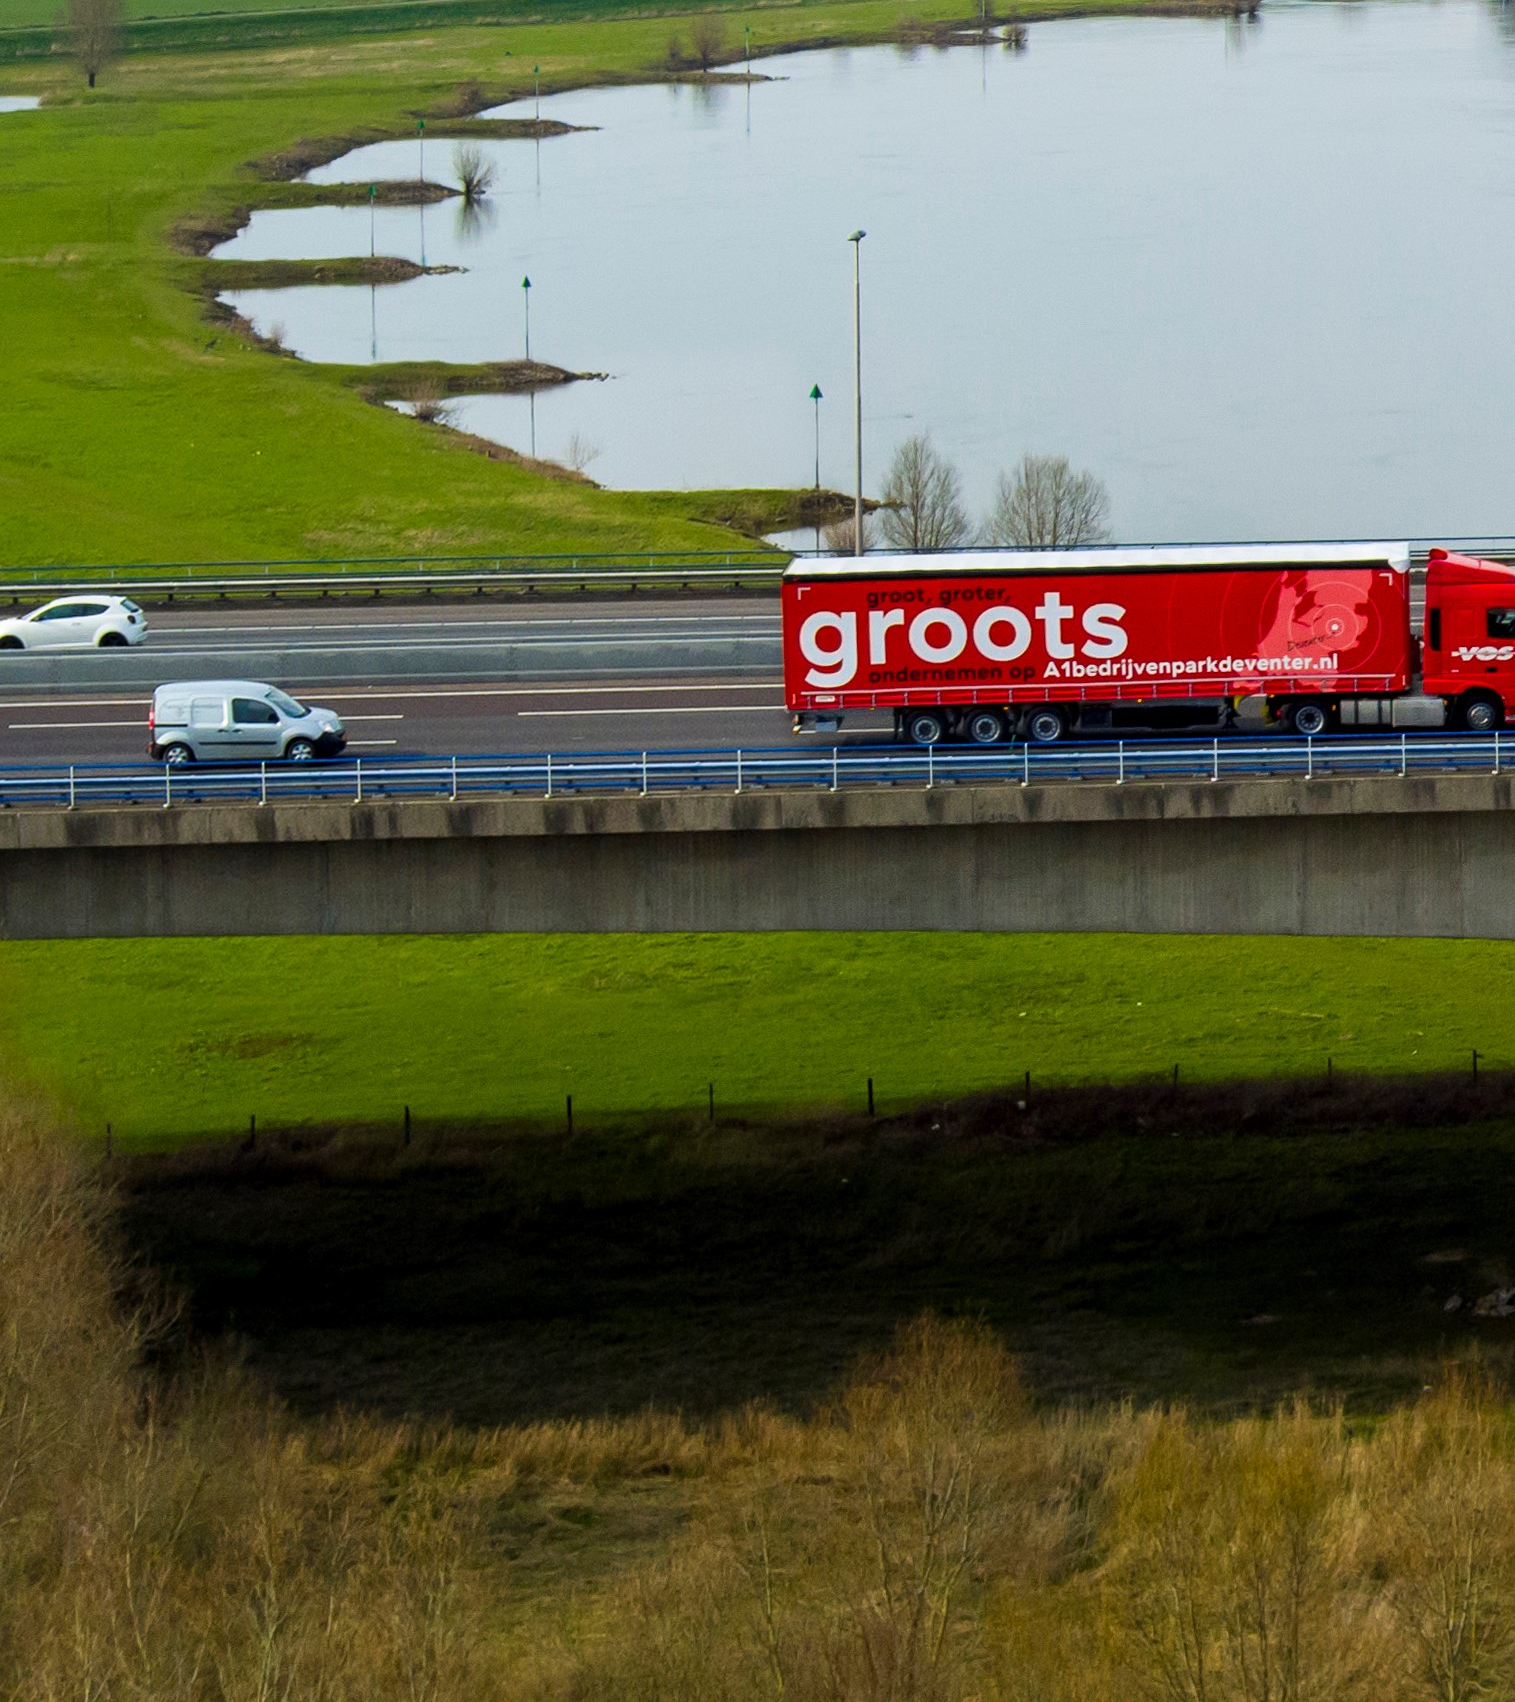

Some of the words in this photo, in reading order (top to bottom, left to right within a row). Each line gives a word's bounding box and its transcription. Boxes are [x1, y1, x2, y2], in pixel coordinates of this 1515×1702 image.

[866, 588, 932, 607] groot,
[938, 586, 1011, 606] groter,
[799, 591, 1128, 688] groots
[868, 665, 1003, 684] ondernemen
[1009, 666, 1036, 681] op
[1043, 653, 1339, 680] A1bedrijvenparkdeventer.nl
